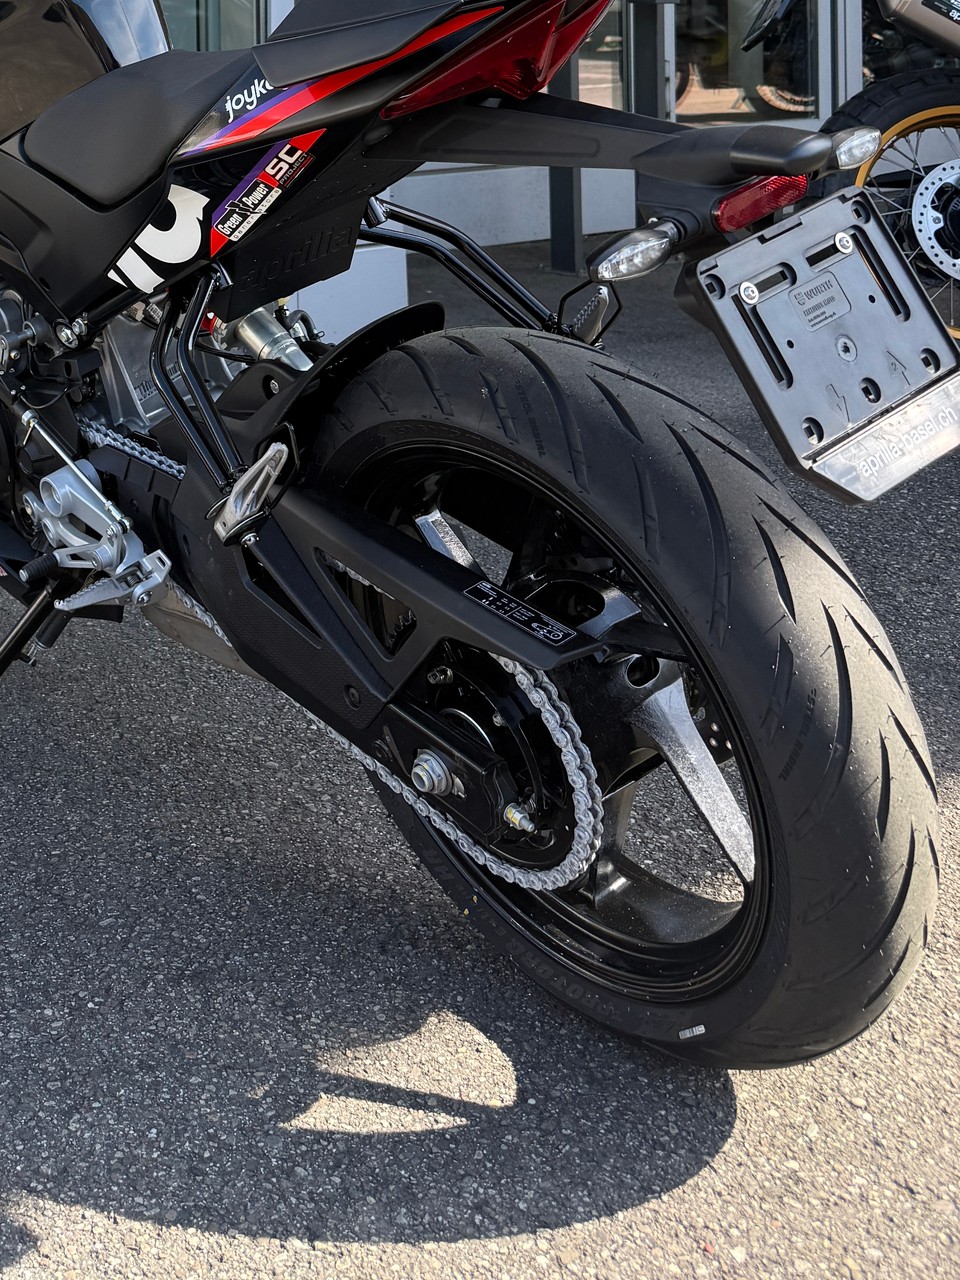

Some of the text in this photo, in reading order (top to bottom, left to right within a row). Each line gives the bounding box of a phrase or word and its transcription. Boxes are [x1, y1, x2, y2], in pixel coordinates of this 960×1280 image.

[264, 143, 304, 181] SC
[279, 153, 308, 185] PROJECT
[217, 183, 270, 235] Green Power
[859, 405, 958, 478] aprilia-basel.ch
